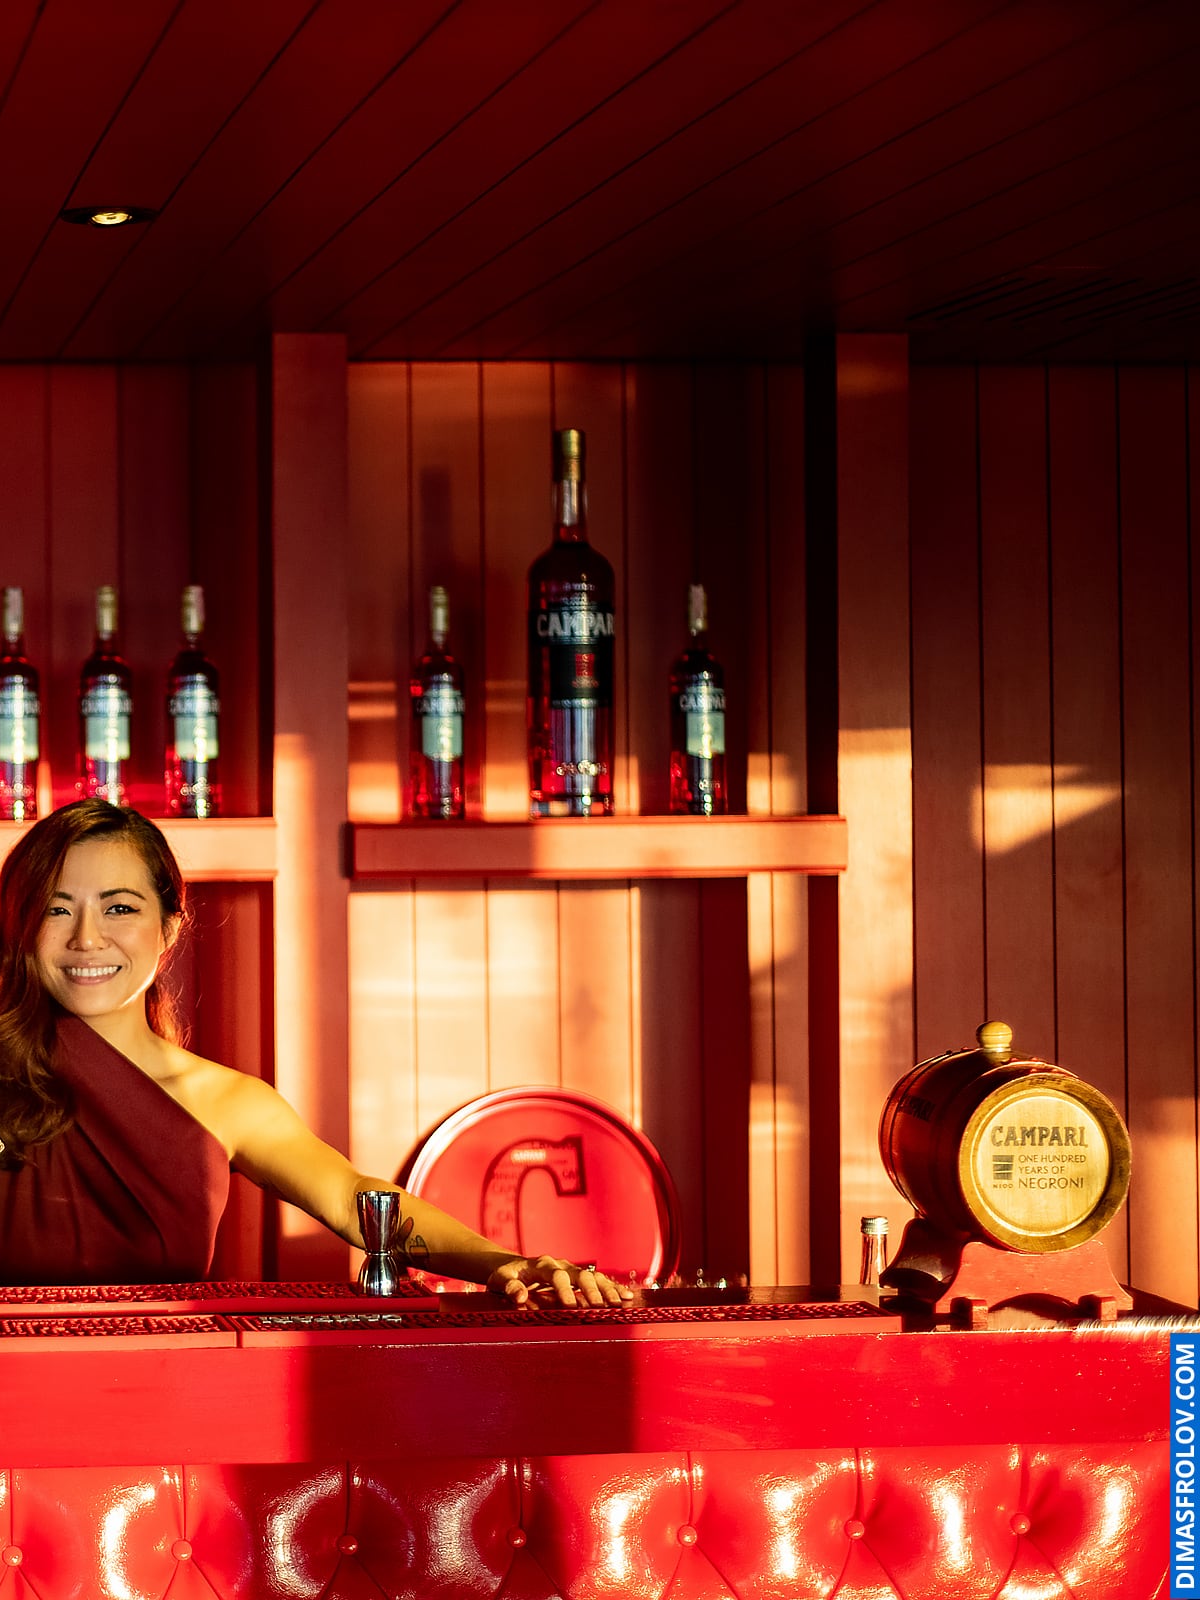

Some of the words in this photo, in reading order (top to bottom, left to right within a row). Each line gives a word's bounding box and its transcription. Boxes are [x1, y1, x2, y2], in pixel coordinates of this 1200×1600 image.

[991, 1126, 1088, 1148] CAMPARI
[1018, 1154, 1039, 1164] ONE
[1041, 1154, 1087, 1164] HUNDRED
[1018, 1166, 1049, 1175] YEARS
[1051, 1166, 1066, 1175] OF
[1018, 1177, 1084, 1190] NEGRONI
